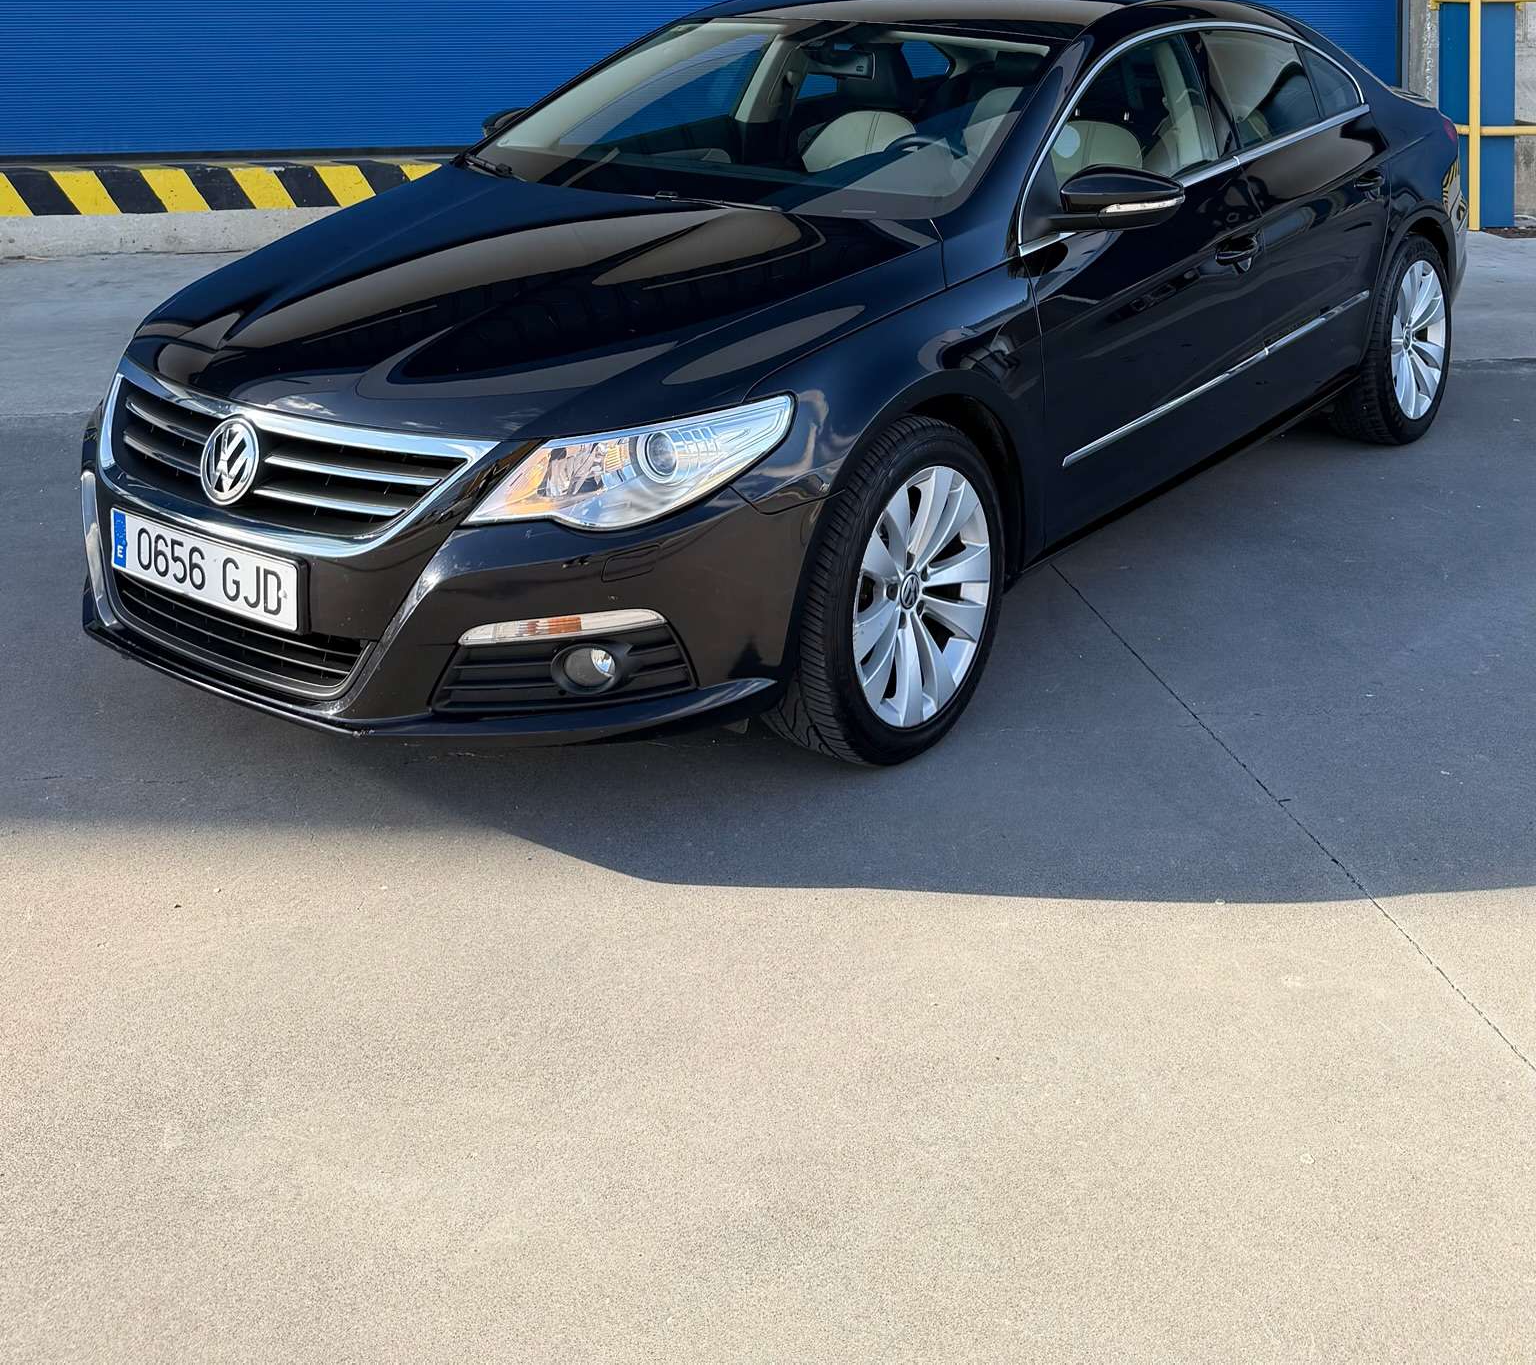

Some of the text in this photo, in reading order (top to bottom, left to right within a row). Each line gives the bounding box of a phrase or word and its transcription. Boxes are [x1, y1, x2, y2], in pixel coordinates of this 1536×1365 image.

[203, 421, 257, 500] VW
[117, 545, 124, 558] E
[137, 527, 282, 616] 0656 GJD
